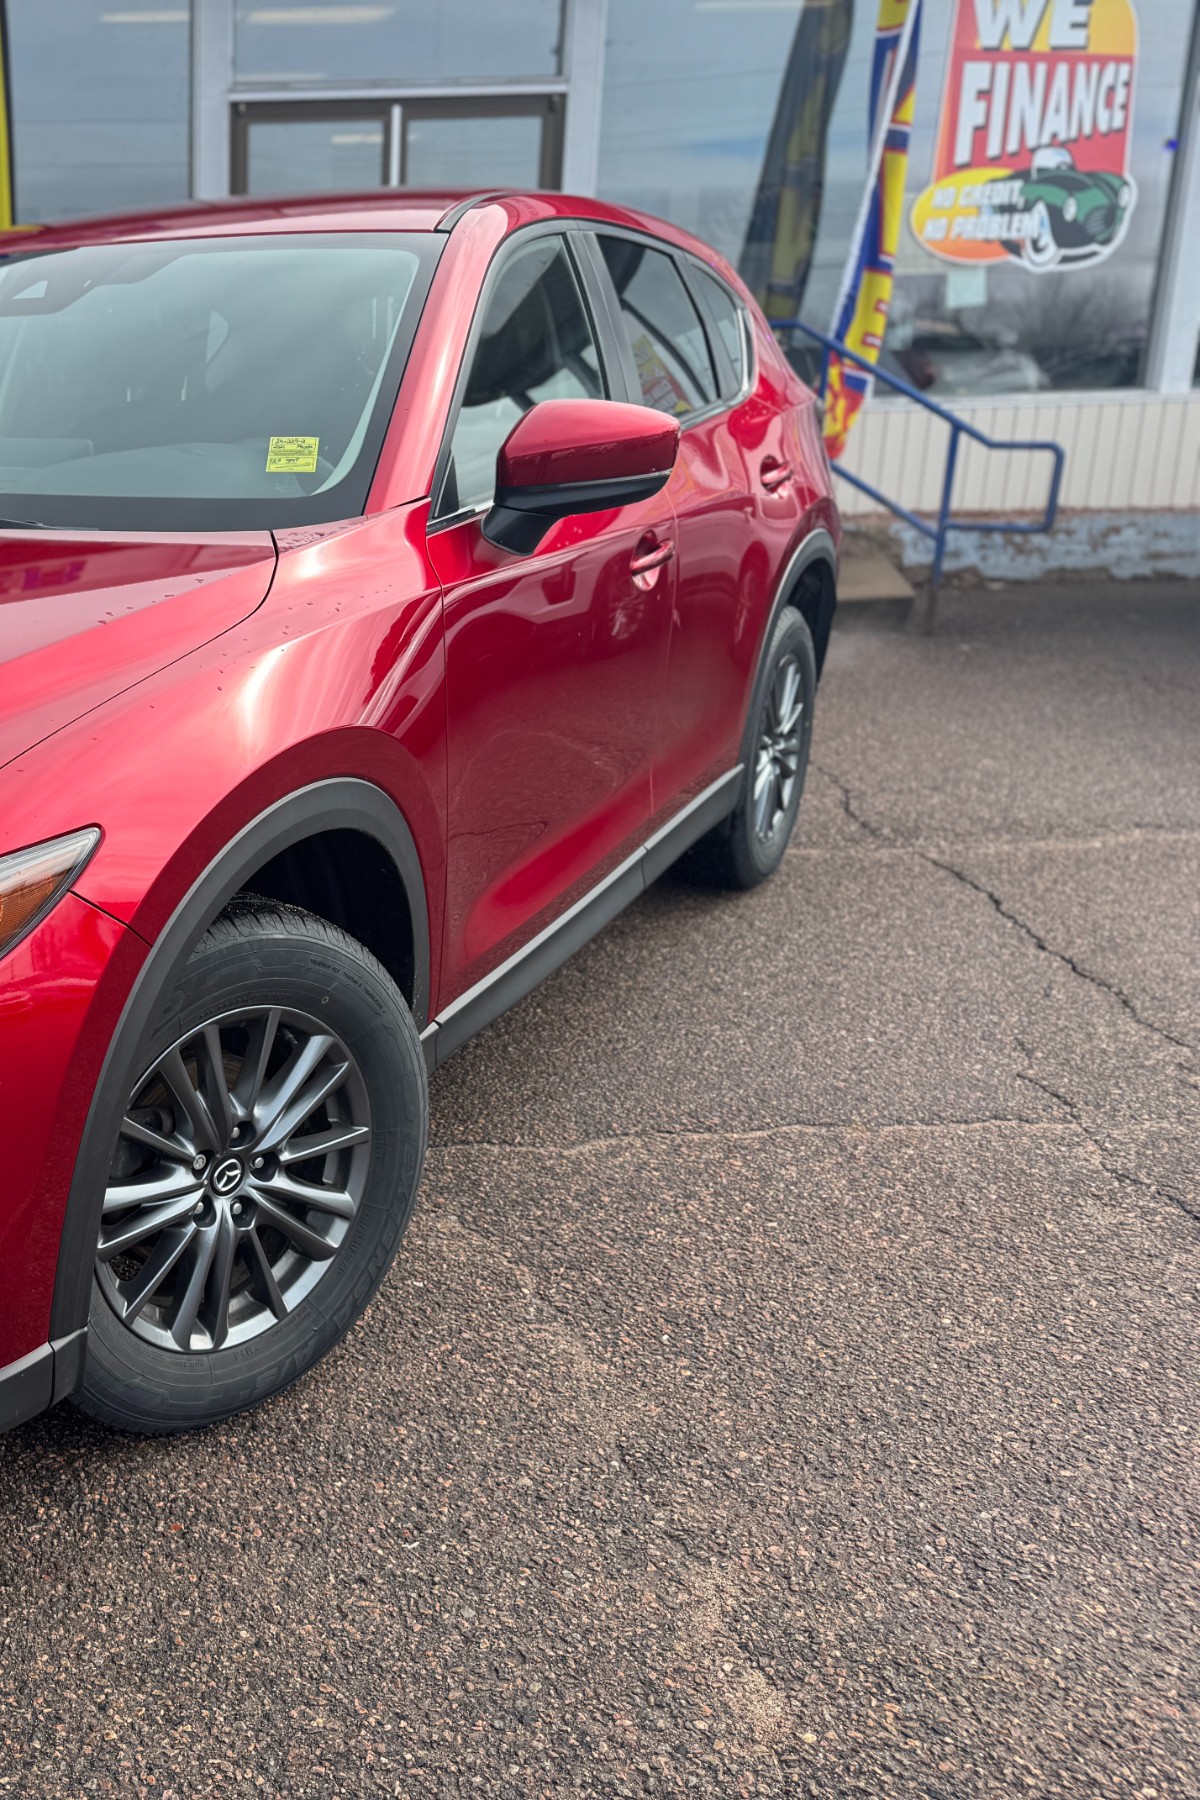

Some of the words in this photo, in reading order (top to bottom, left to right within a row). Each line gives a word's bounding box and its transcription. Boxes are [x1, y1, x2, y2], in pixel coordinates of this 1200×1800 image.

[972, 0, 1093, 51] WE
[953, 61, 1131, 168] FINANCE
[931, 187, 957, 209] NO
[923, 217, 949, 241] NO
